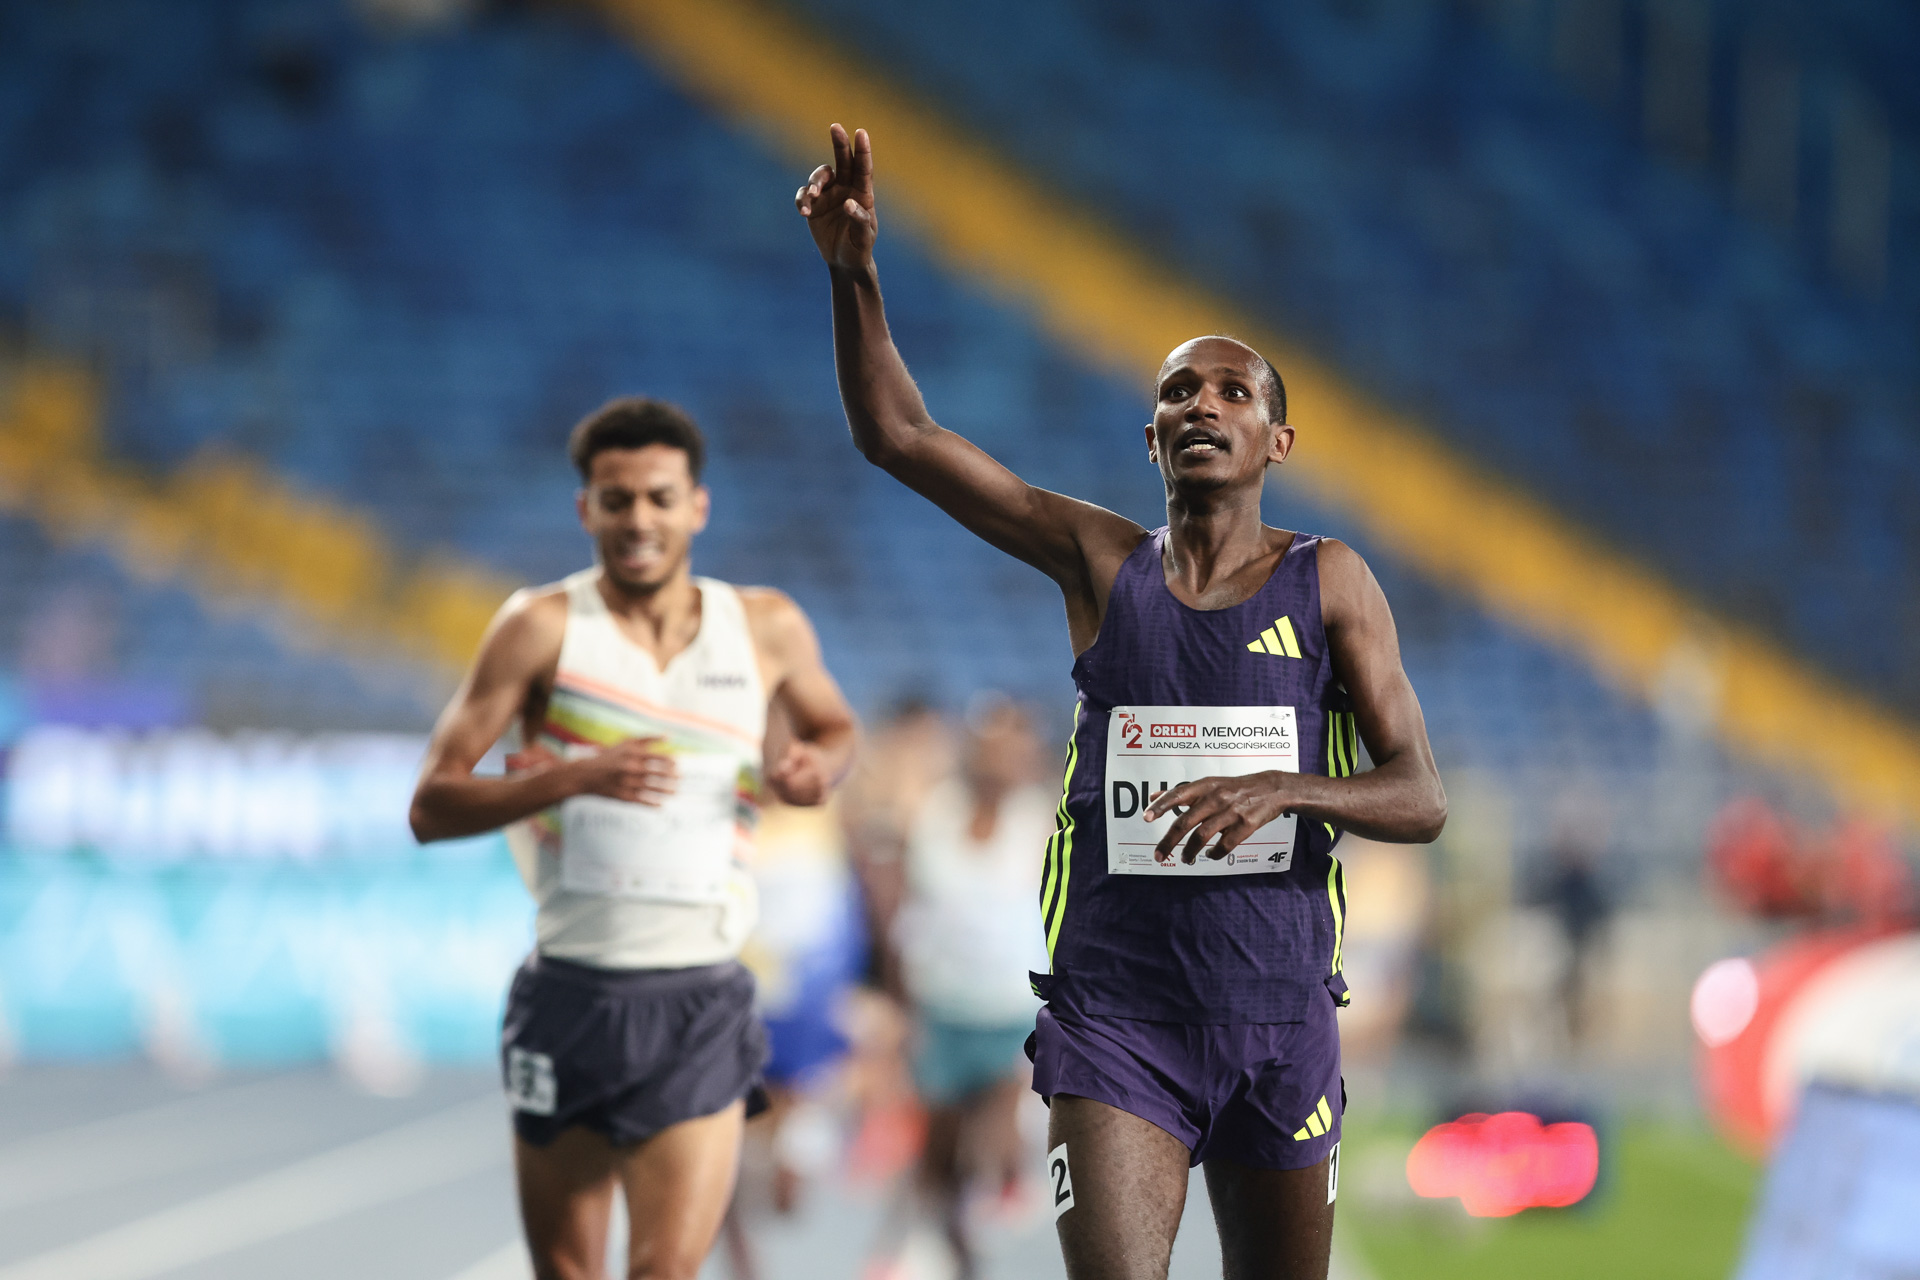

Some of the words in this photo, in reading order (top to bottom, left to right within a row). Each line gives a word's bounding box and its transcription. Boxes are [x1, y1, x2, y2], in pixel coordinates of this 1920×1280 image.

[1152, 725, 1195, 737] ORLEN
[1202, 726, 1289, 737] MEMORIAŁ
[1149, 741, 1201, 749] JANUSZA
[1204, 740, 1291, 750] KUSOCIŃSKIEGO
[1268, 852, 1288, 863] 4F
[1331, 1145, 1338, 1190] 1
[1051, 1158, 1071, 1208] 2
